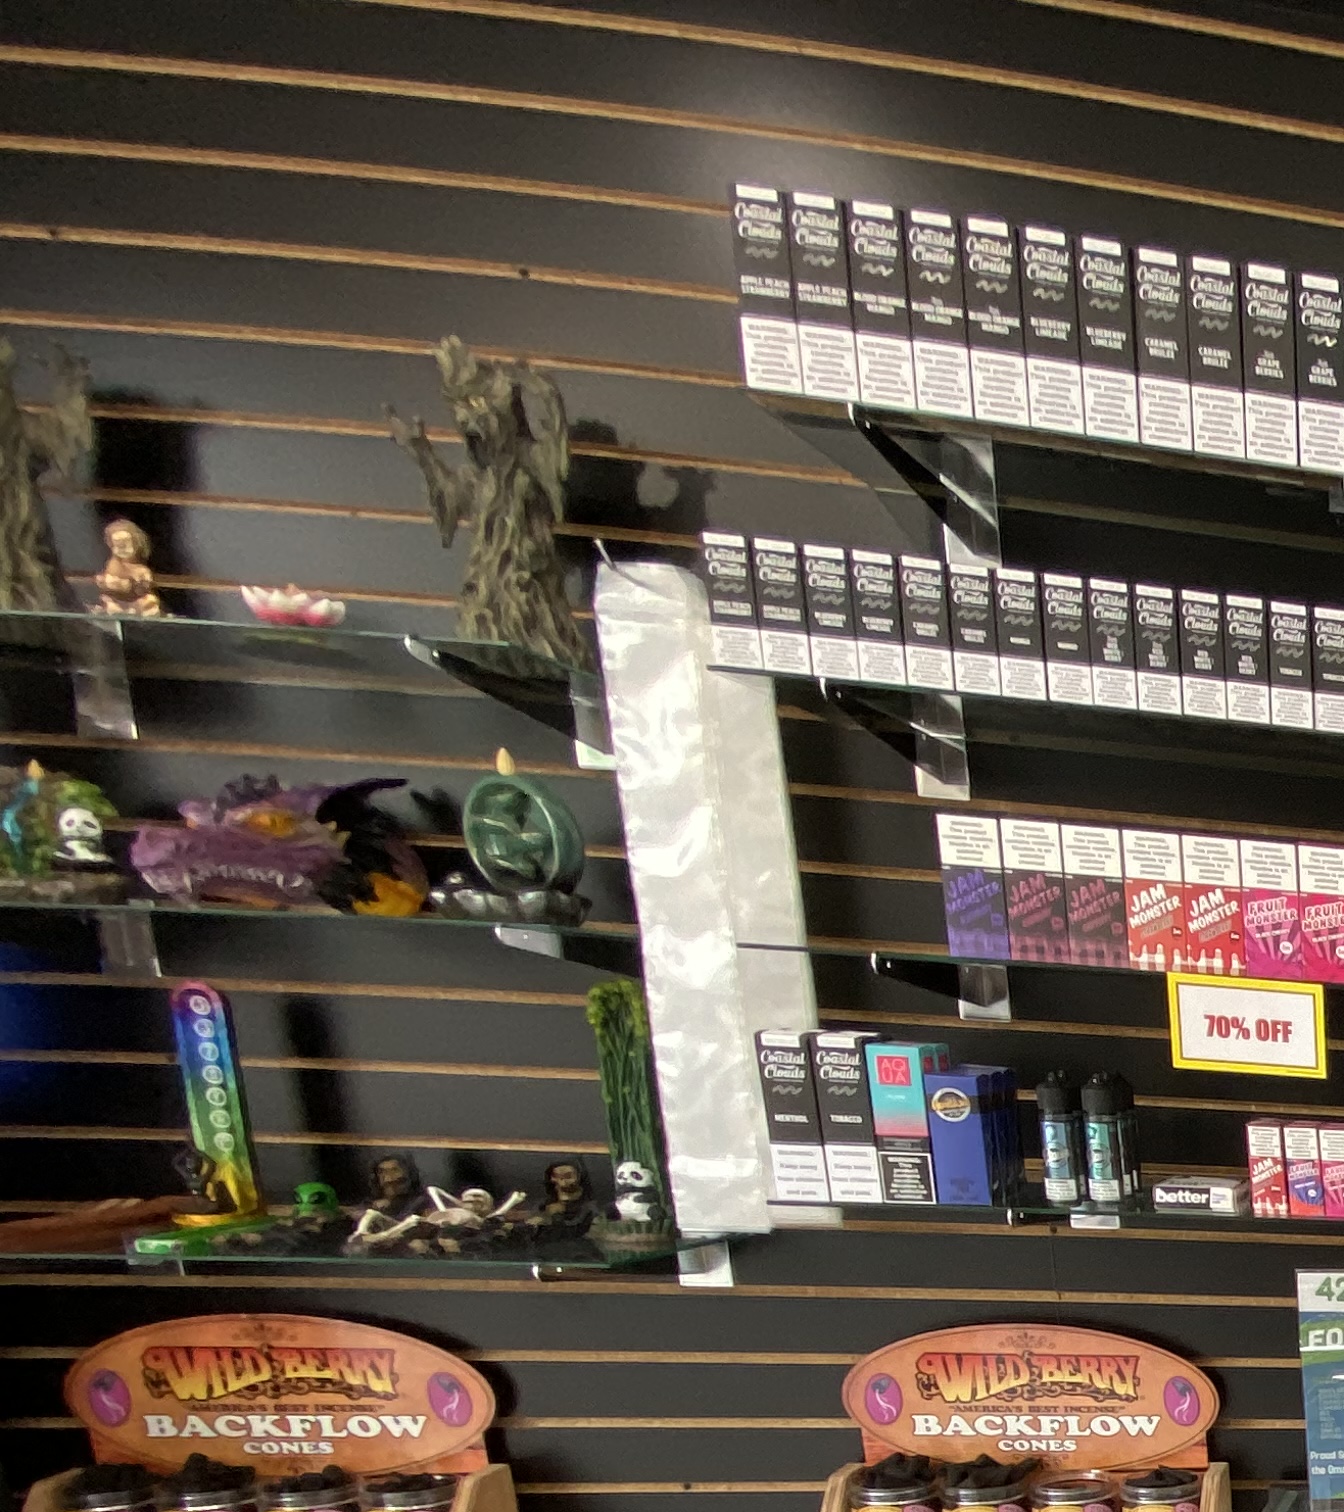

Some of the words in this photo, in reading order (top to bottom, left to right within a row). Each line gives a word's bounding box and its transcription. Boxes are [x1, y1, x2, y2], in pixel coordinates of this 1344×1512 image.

[1130, 884, 1167, 913] JAM
[1189, 888, 1226, 917] JAM
[1249, 897, 1287, 915] FRUIT
[1130, 895, 1182, 929] MONSTER
[1187, 900, 1240, 933] MONSTER
[1245, 909, 1298, 926] MONSTER
[1305, 902, 1344, 920] FRUIT
[1204, 1015, 1250, 1039] 70%
[1256, 1019, 1292, 1044] OFF
[761, 1051, 806, 1065] Coastal
[816, 1051, 861, 1065] Coastal
[764, 1066, 806, 1079] Clouds
[819, 1066, 860, 1079] Clouds
[1253, 1158, 1274, 1175] JAM
[1156, 1188, 1208, 1204] better
[143, 1347, 270, 1400] WILD
[273, 1348, 396, 1396] BERRY
[916, 1352, 1031, 1402] WILD
[1033, 1354, 1140, 1401] BERRY
[143, 1414, 427, 1439] BACKFLOW
[912, 1414, 1161, 1437] BACKFLOW
[243, 1442, 335, 1454] CONES
[998, 1439, 1077, 1452] CONES
